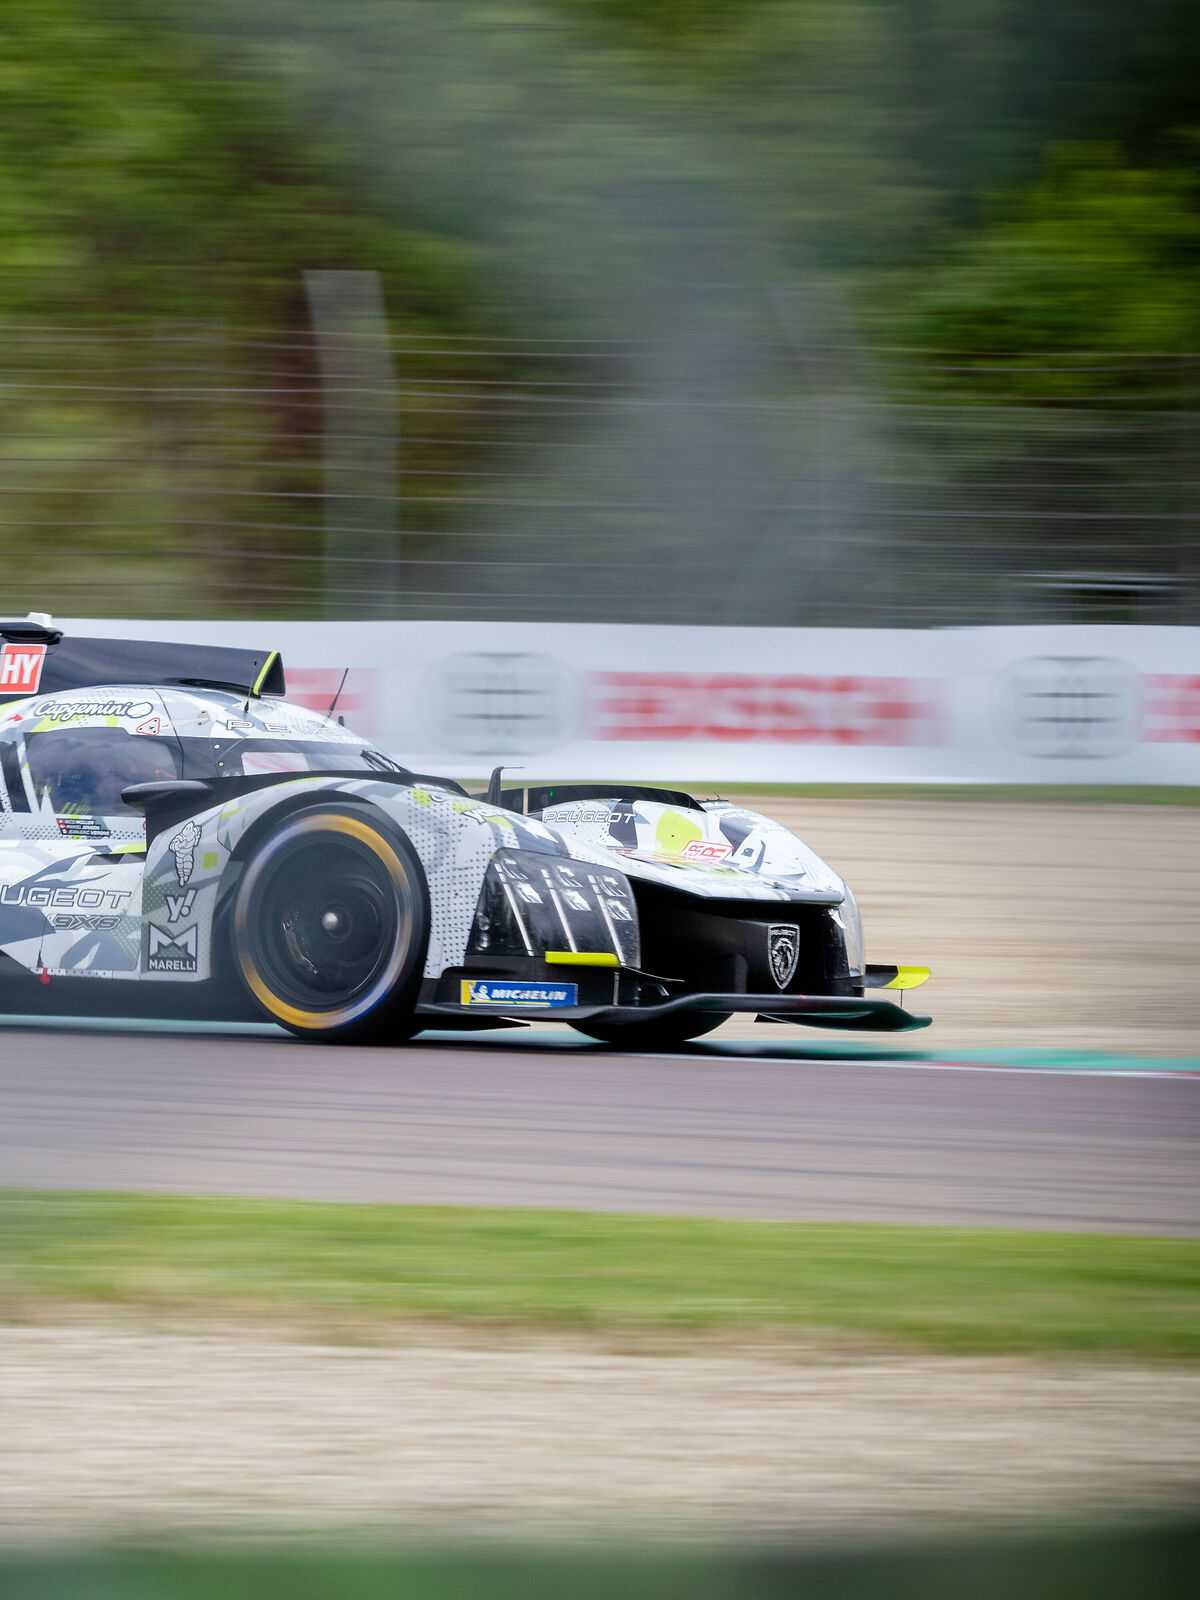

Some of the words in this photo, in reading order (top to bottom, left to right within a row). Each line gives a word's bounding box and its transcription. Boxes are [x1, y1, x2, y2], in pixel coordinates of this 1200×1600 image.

[0, 653, 41, 684] HY
[34, 699, 134, 722] Capgemini
[543, 809, 637, 824] PEUGEOT
[52, 914, 122, 930] 9X8
[149, 959, 197, 971] MARELLI
[491, 989, 567, 1000] MICHELIN
